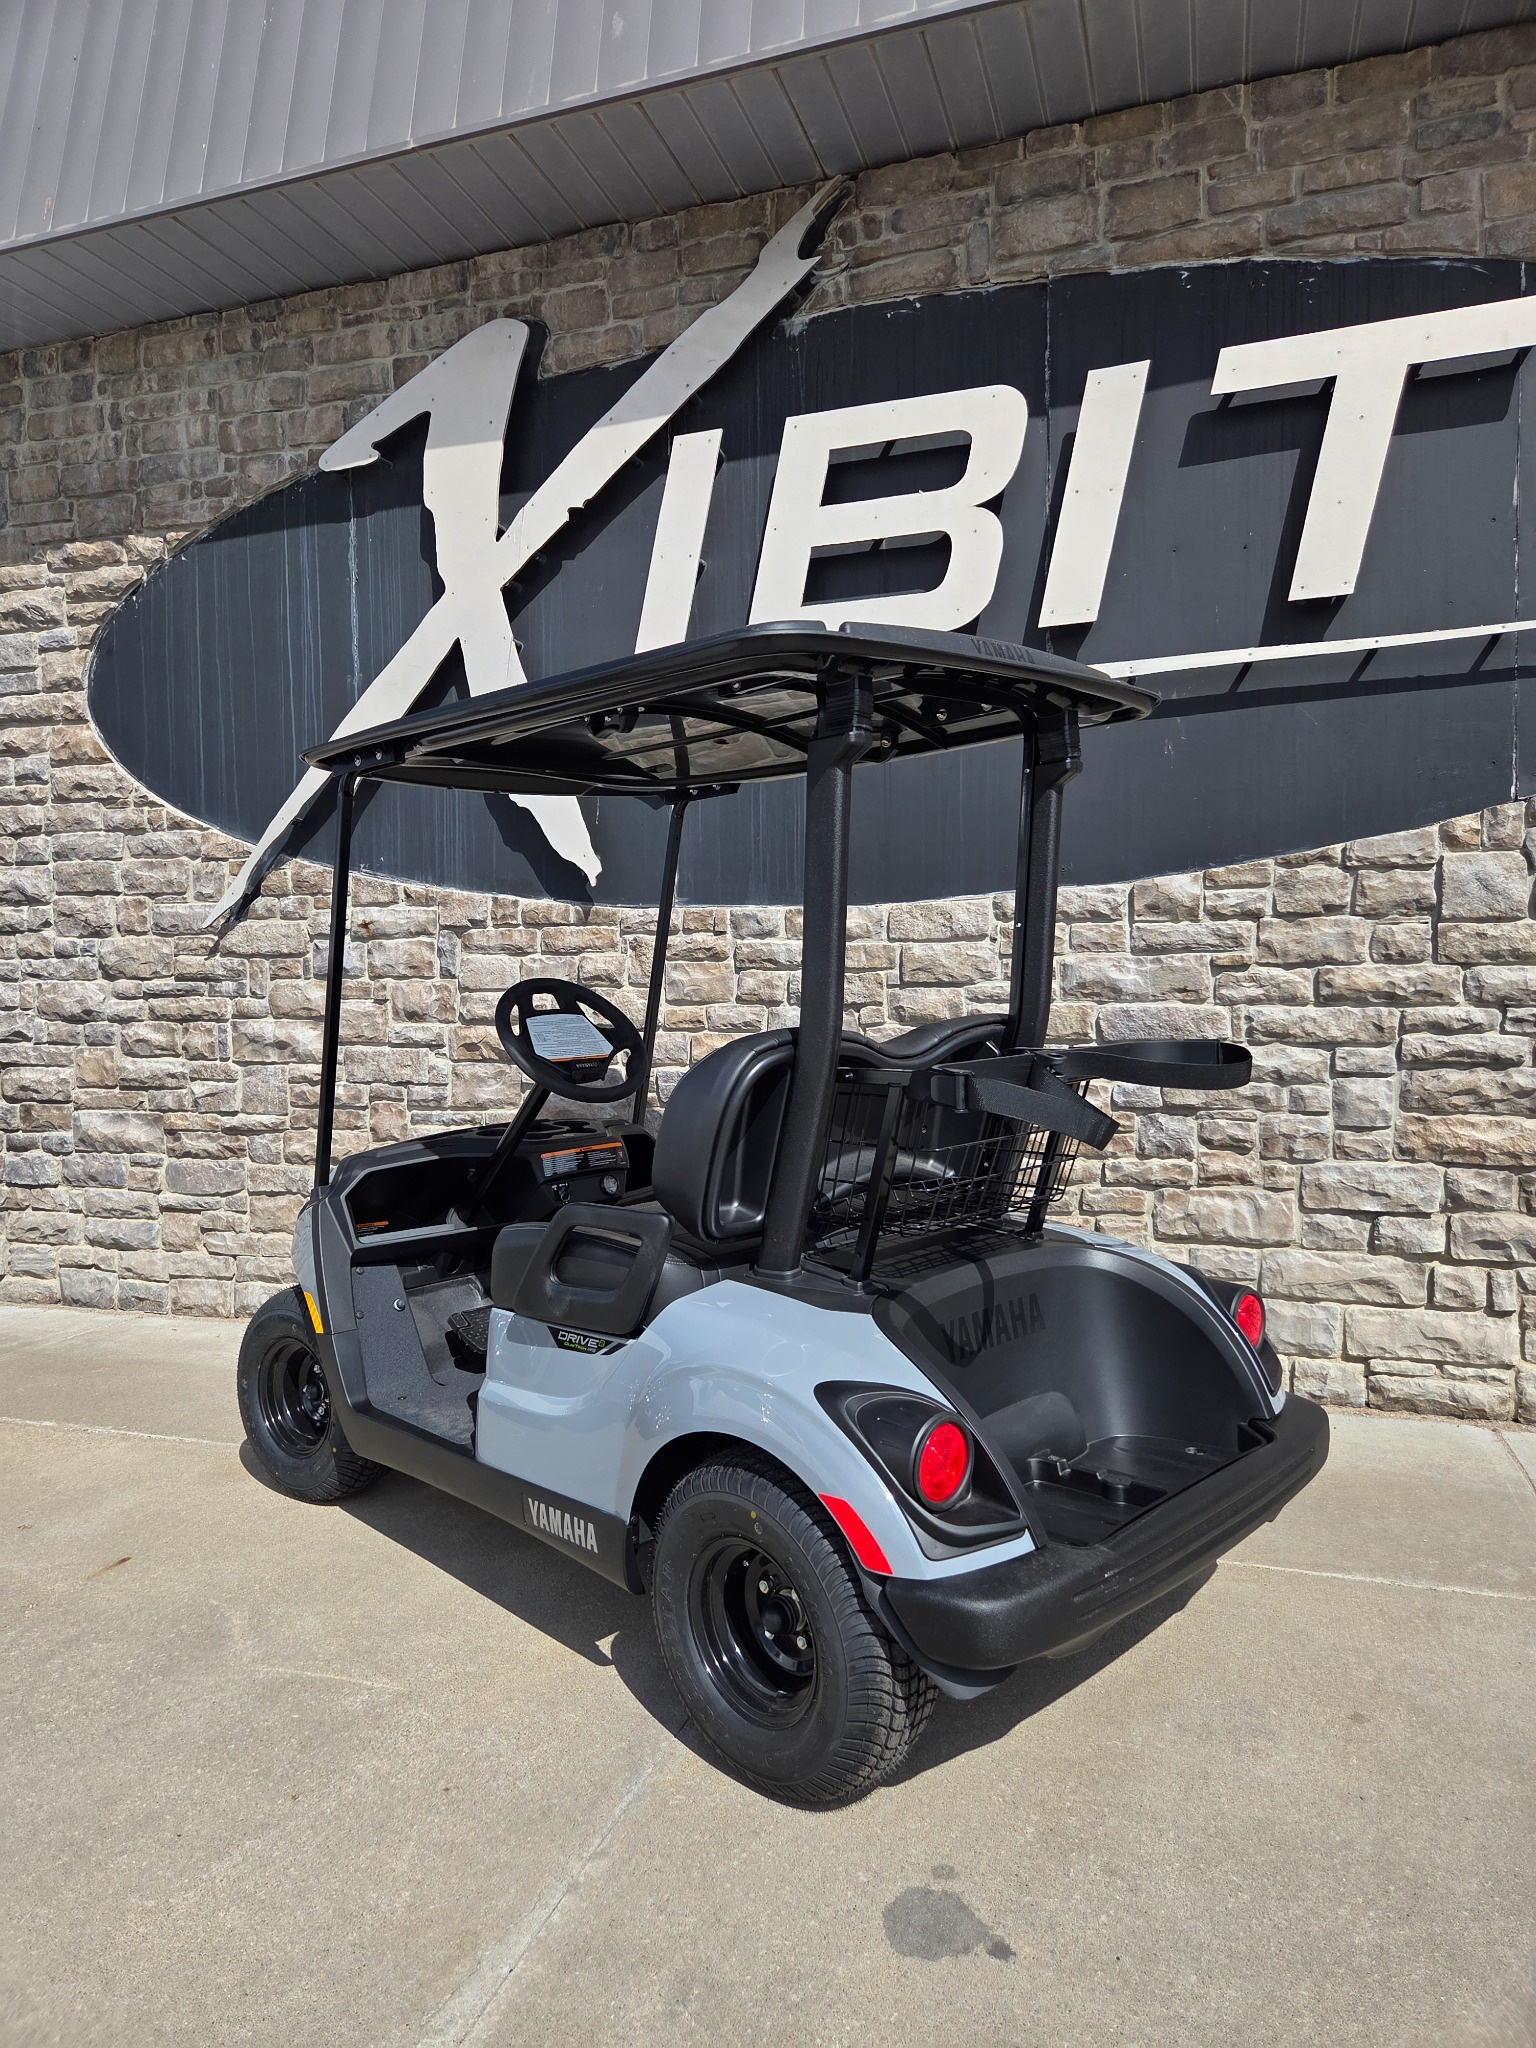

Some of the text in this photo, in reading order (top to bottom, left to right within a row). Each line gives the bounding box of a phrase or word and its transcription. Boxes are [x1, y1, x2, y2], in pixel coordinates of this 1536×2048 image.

[969, 636, 1036, 664] YAMAHA
[939, 1291, 1047, 1364] YAMAHA
[527, 1497, 599, 1554] YAMAHA
